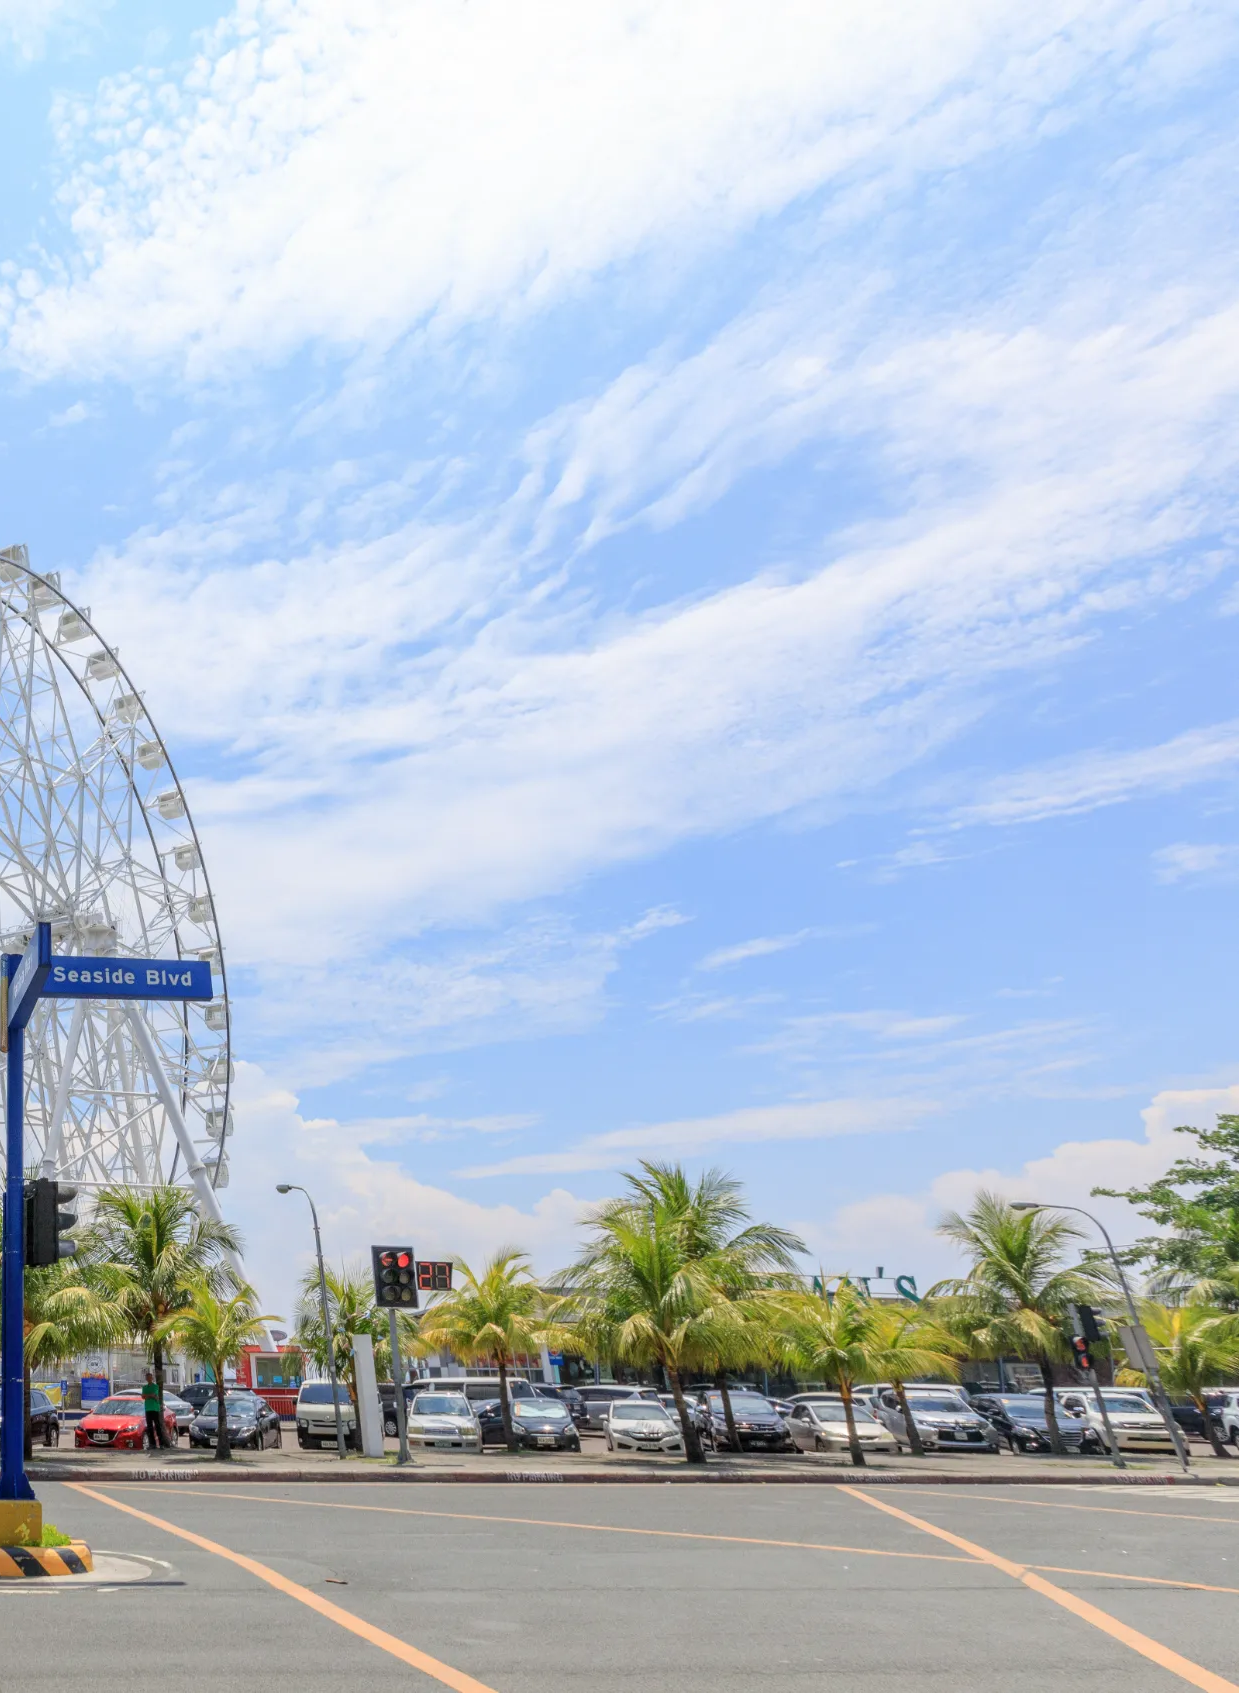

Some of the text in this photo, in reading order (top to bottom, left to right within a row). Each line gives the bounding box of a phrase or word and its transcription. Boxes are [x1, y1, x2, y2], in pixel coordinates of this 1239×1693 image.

[53, 966, 135, 985] Seaside
[146, 969, 192, 987] Blvd
[418, 1262, 451, 1290] 27
[132, 1468, 146, 1480] NO
